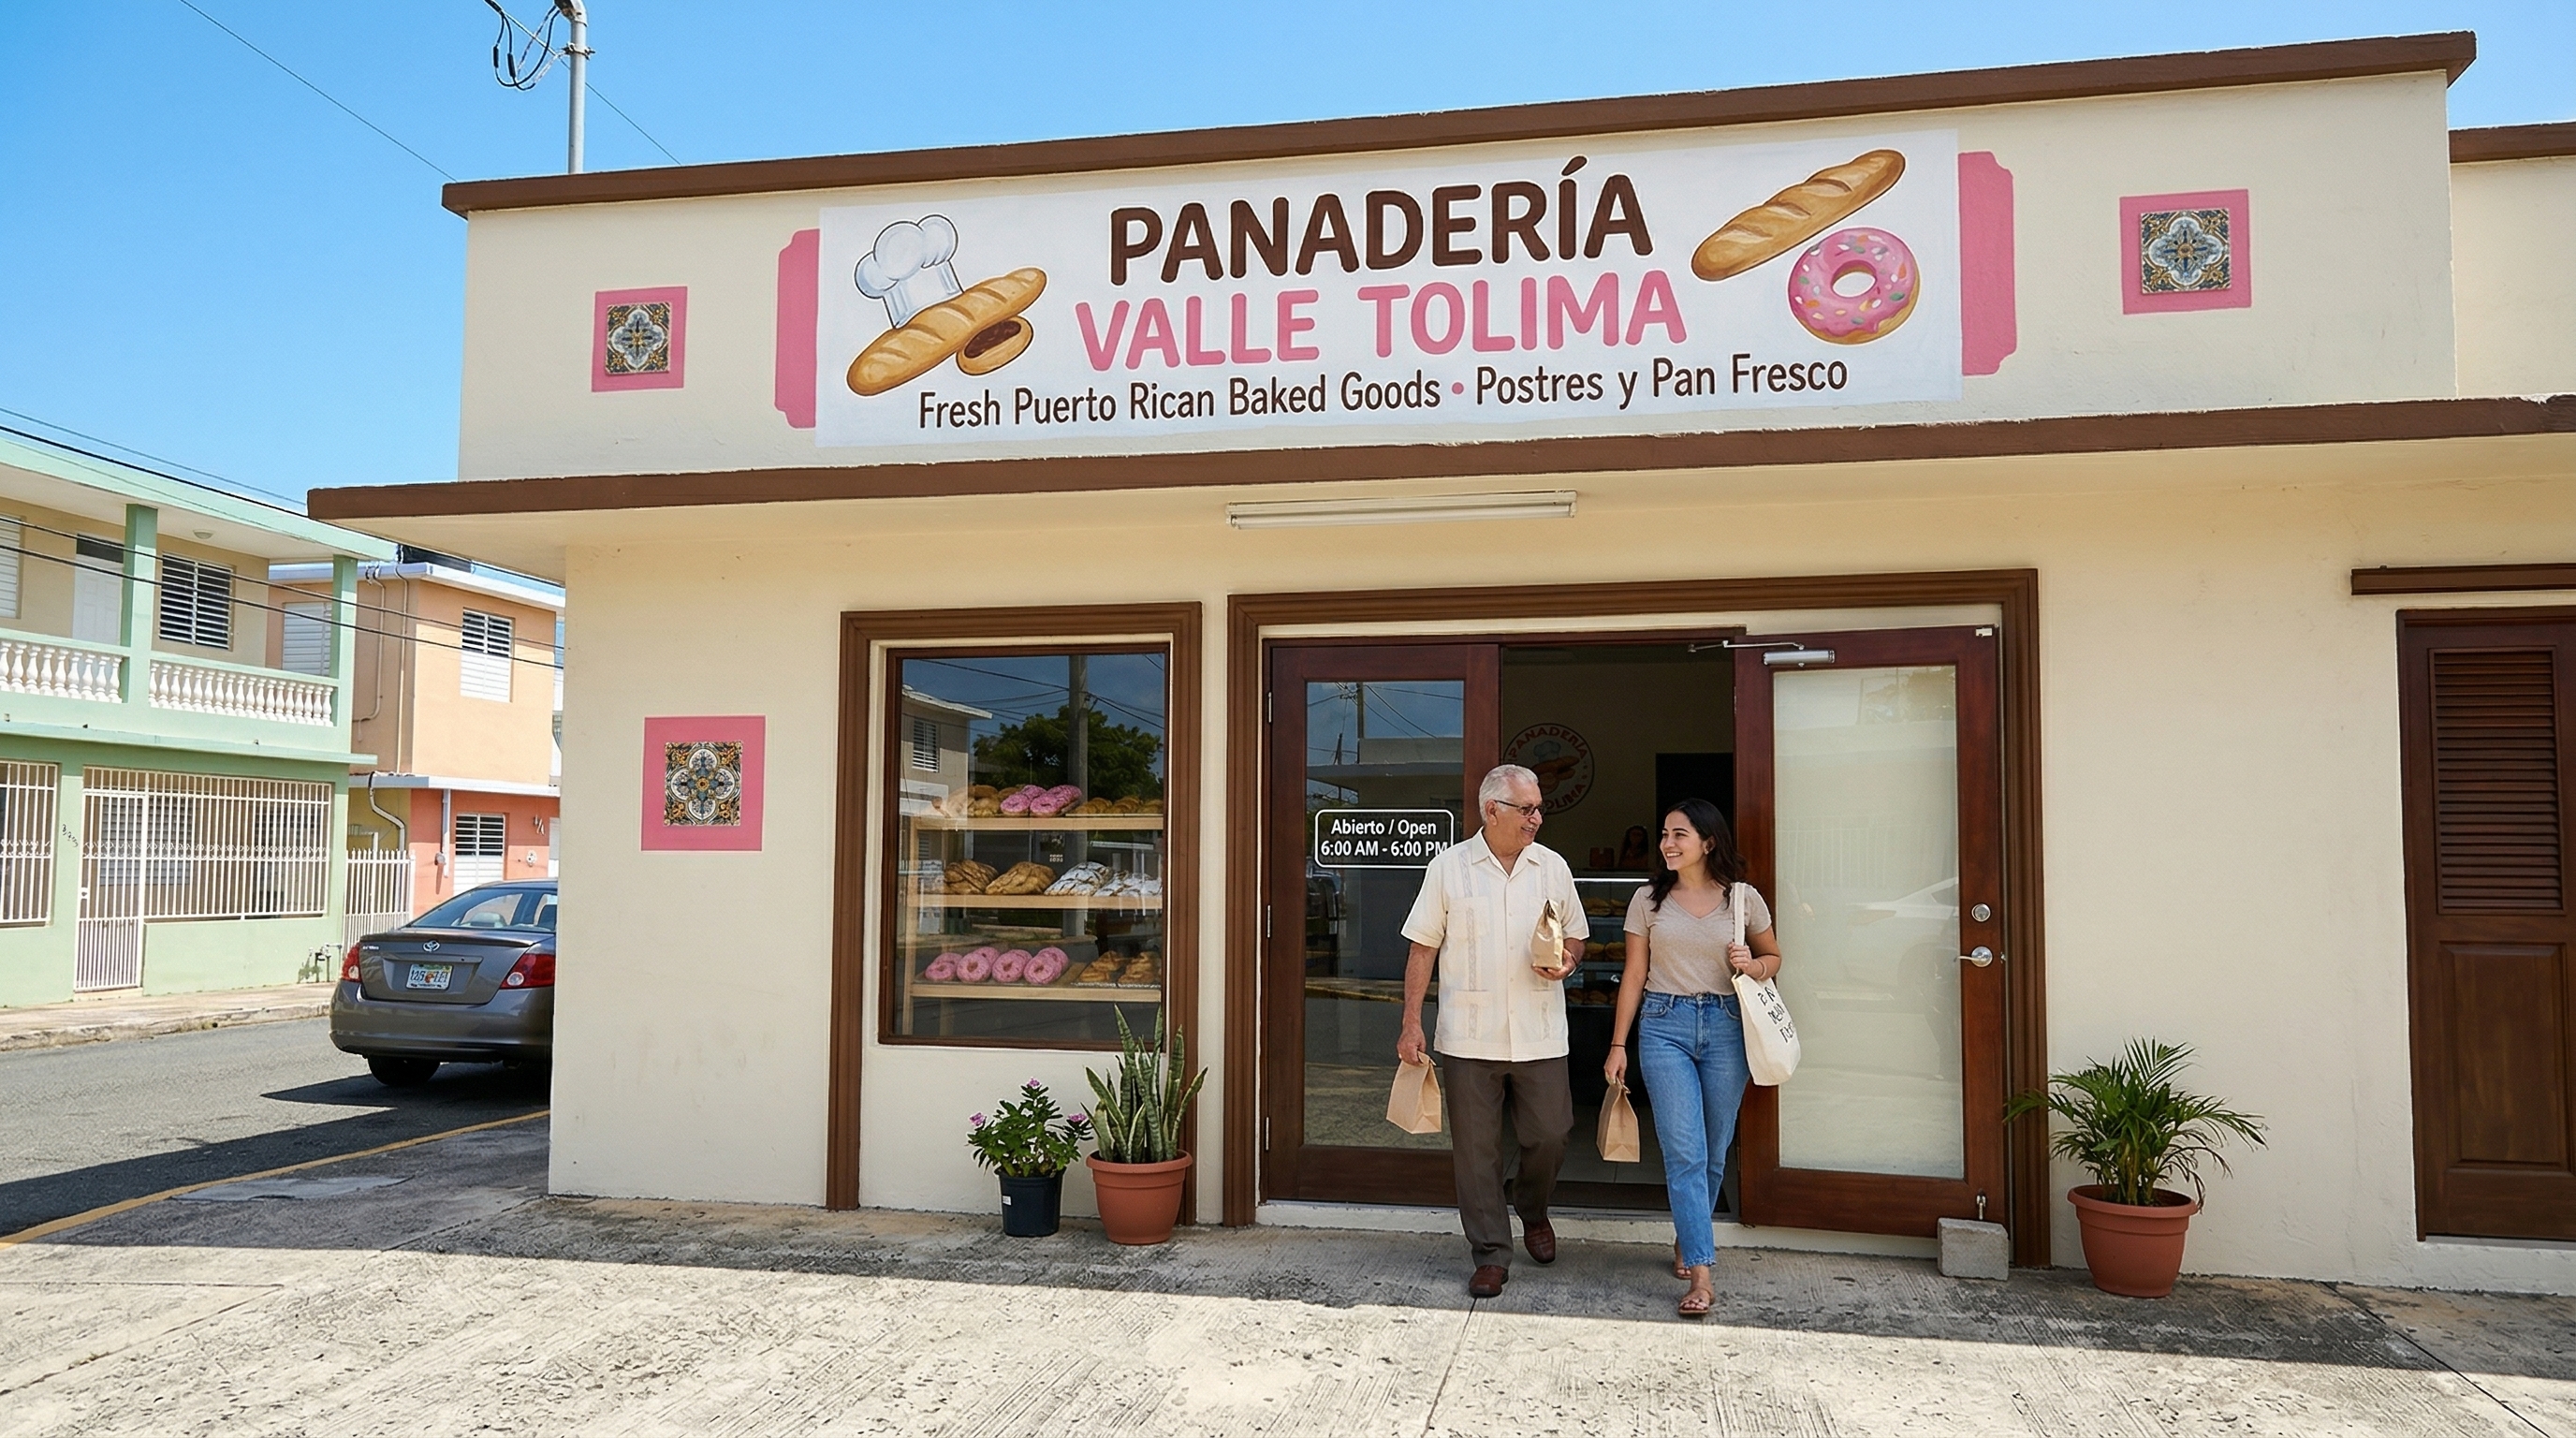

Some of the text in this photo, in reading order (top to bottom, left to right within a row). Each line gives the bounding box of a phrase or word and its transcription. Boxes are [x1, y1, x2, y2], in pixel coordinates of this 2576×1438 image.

[1110, 155, 1654, 286] PANADERÍA
[1076, 270, 1687, 372] VALLE TOLIMA
[919, 389, 1001, 429] Fresh
[1015, 387, 1117, 425] Puerto
[1130, 382, 1215, 419] Rican
[1229, 374, 1326, 415] Baked
[1340, 369, 1441, 411] Goods
[1477, 365, 1604, 405] Postres
[1617, 371, 1638, 410] y
[1653, 357, 1715, 398] Pan
[1732, 353, 1848, 394] Fresco
[1544, 784, 1587, 810] OLIMA
[1321, 841, 1352, 856] 6:00
[1354, 841, 1379, 856] AM
[1390, 841, 1422, 857] 6:00
[1331, 818, 1385, 835] Abierto
[1398, 819, 1437, 840] Open
